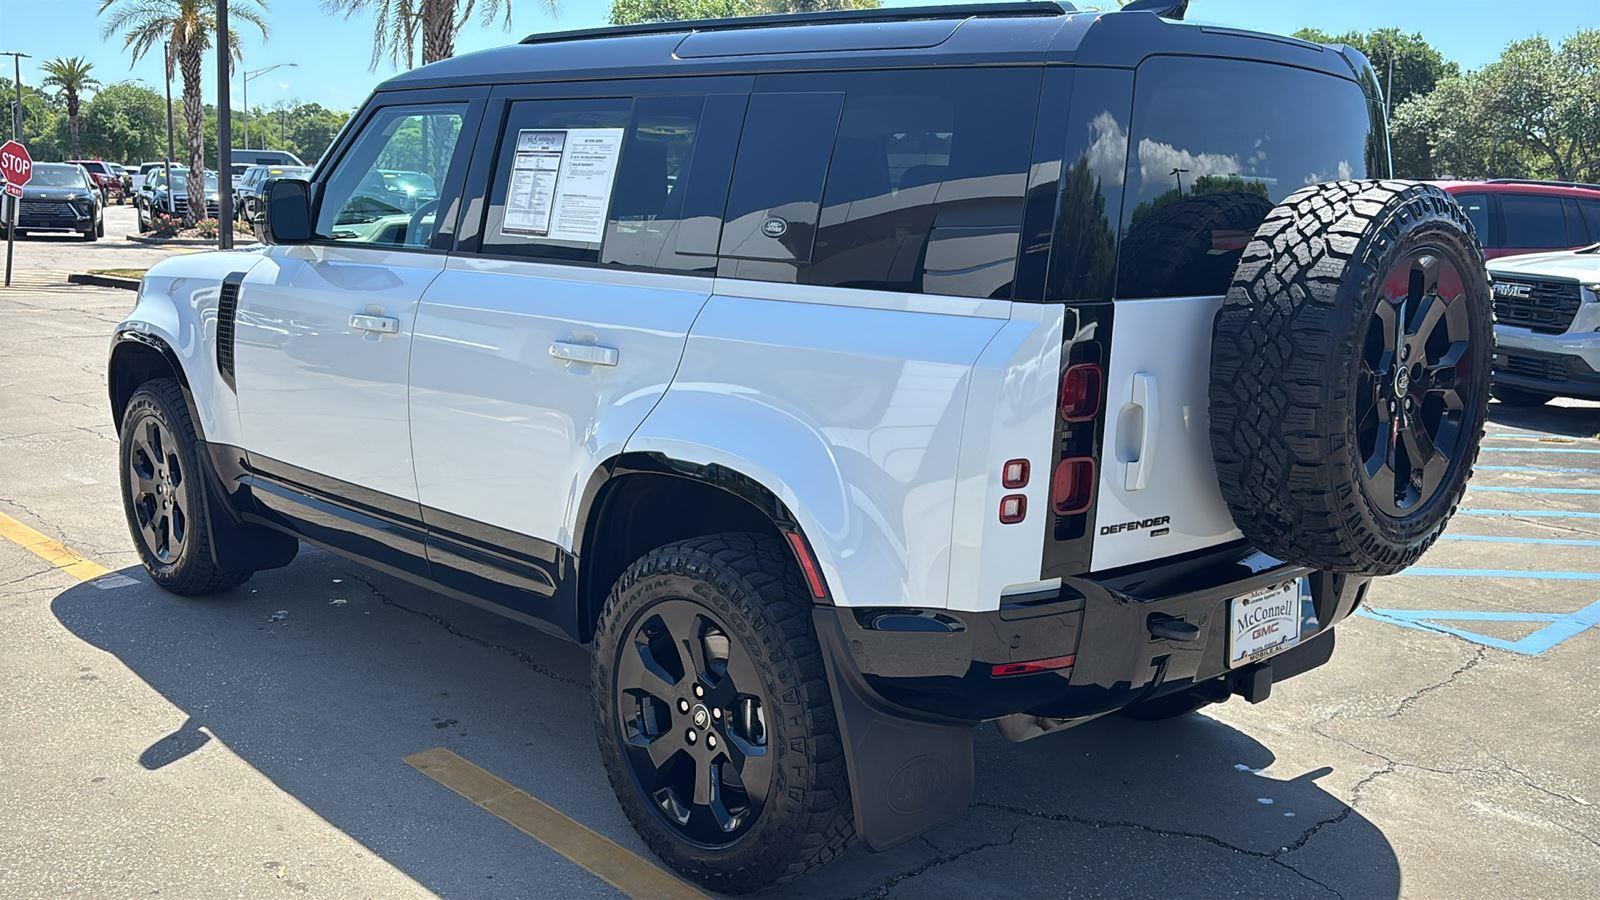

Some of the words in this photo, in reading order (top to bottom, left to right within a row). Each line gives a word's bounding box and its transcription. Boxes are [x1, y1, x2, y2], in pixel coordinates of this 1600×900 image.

[1, 151, 30, 175] STOP
[1493, 284, 1531, 298] GMC
[1100, 515, 1171, 535] DEFENDER
[1238, 601, 1292, 633] McConnell
[1252, 622, 1280, 640] GMC
[1249, 649, 1274, 661] MOBILE
